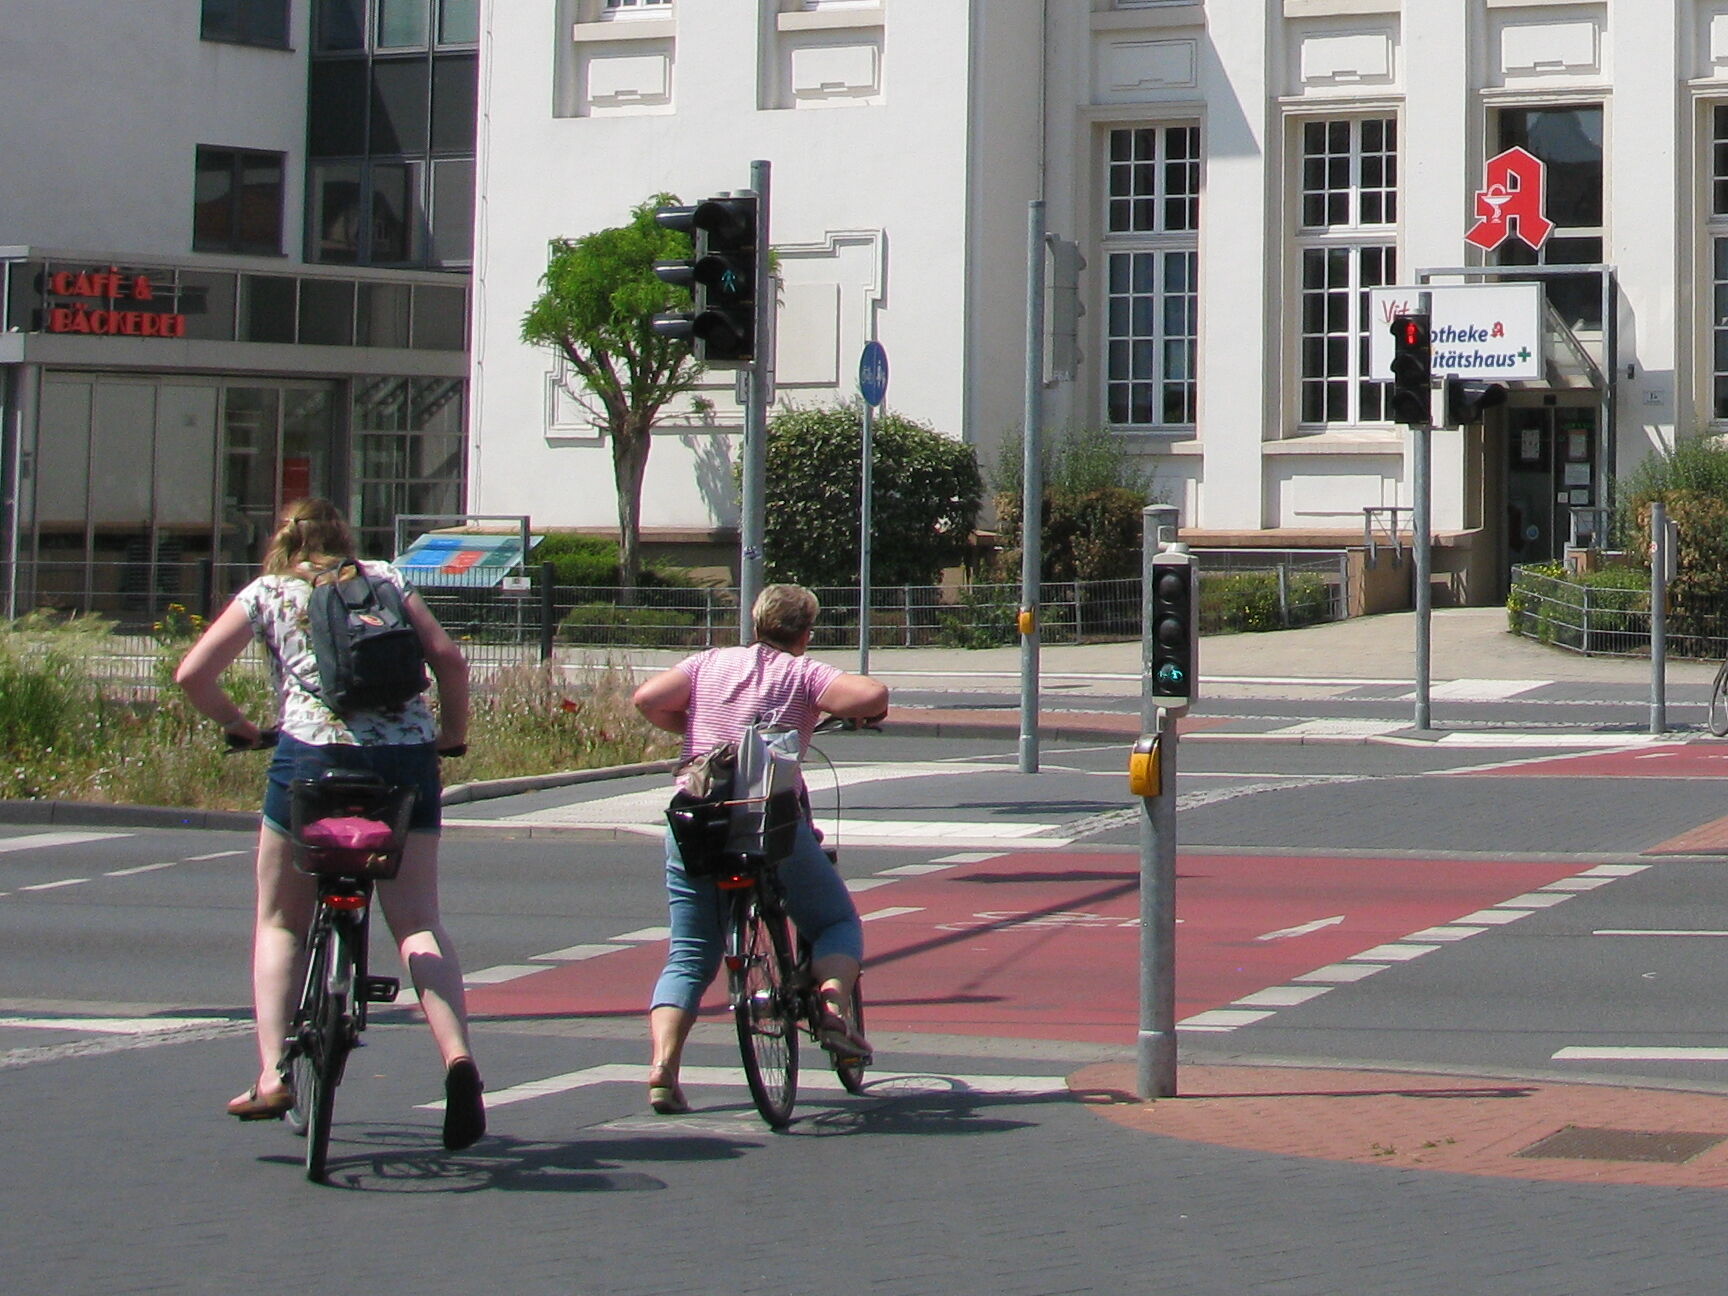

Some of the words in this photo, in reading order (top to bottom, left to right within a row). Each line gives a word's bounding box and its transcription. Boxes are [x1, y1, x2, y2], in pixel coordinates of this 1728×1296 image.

[132, 275, 153, 300] &
[50, 302, 186, 337] BÄCKEREI
[1381, 299, 1410, 323] Vit
[1431, 324, 1489, 344] otheke
[1432, 350, 1516, 369] itätshaus
